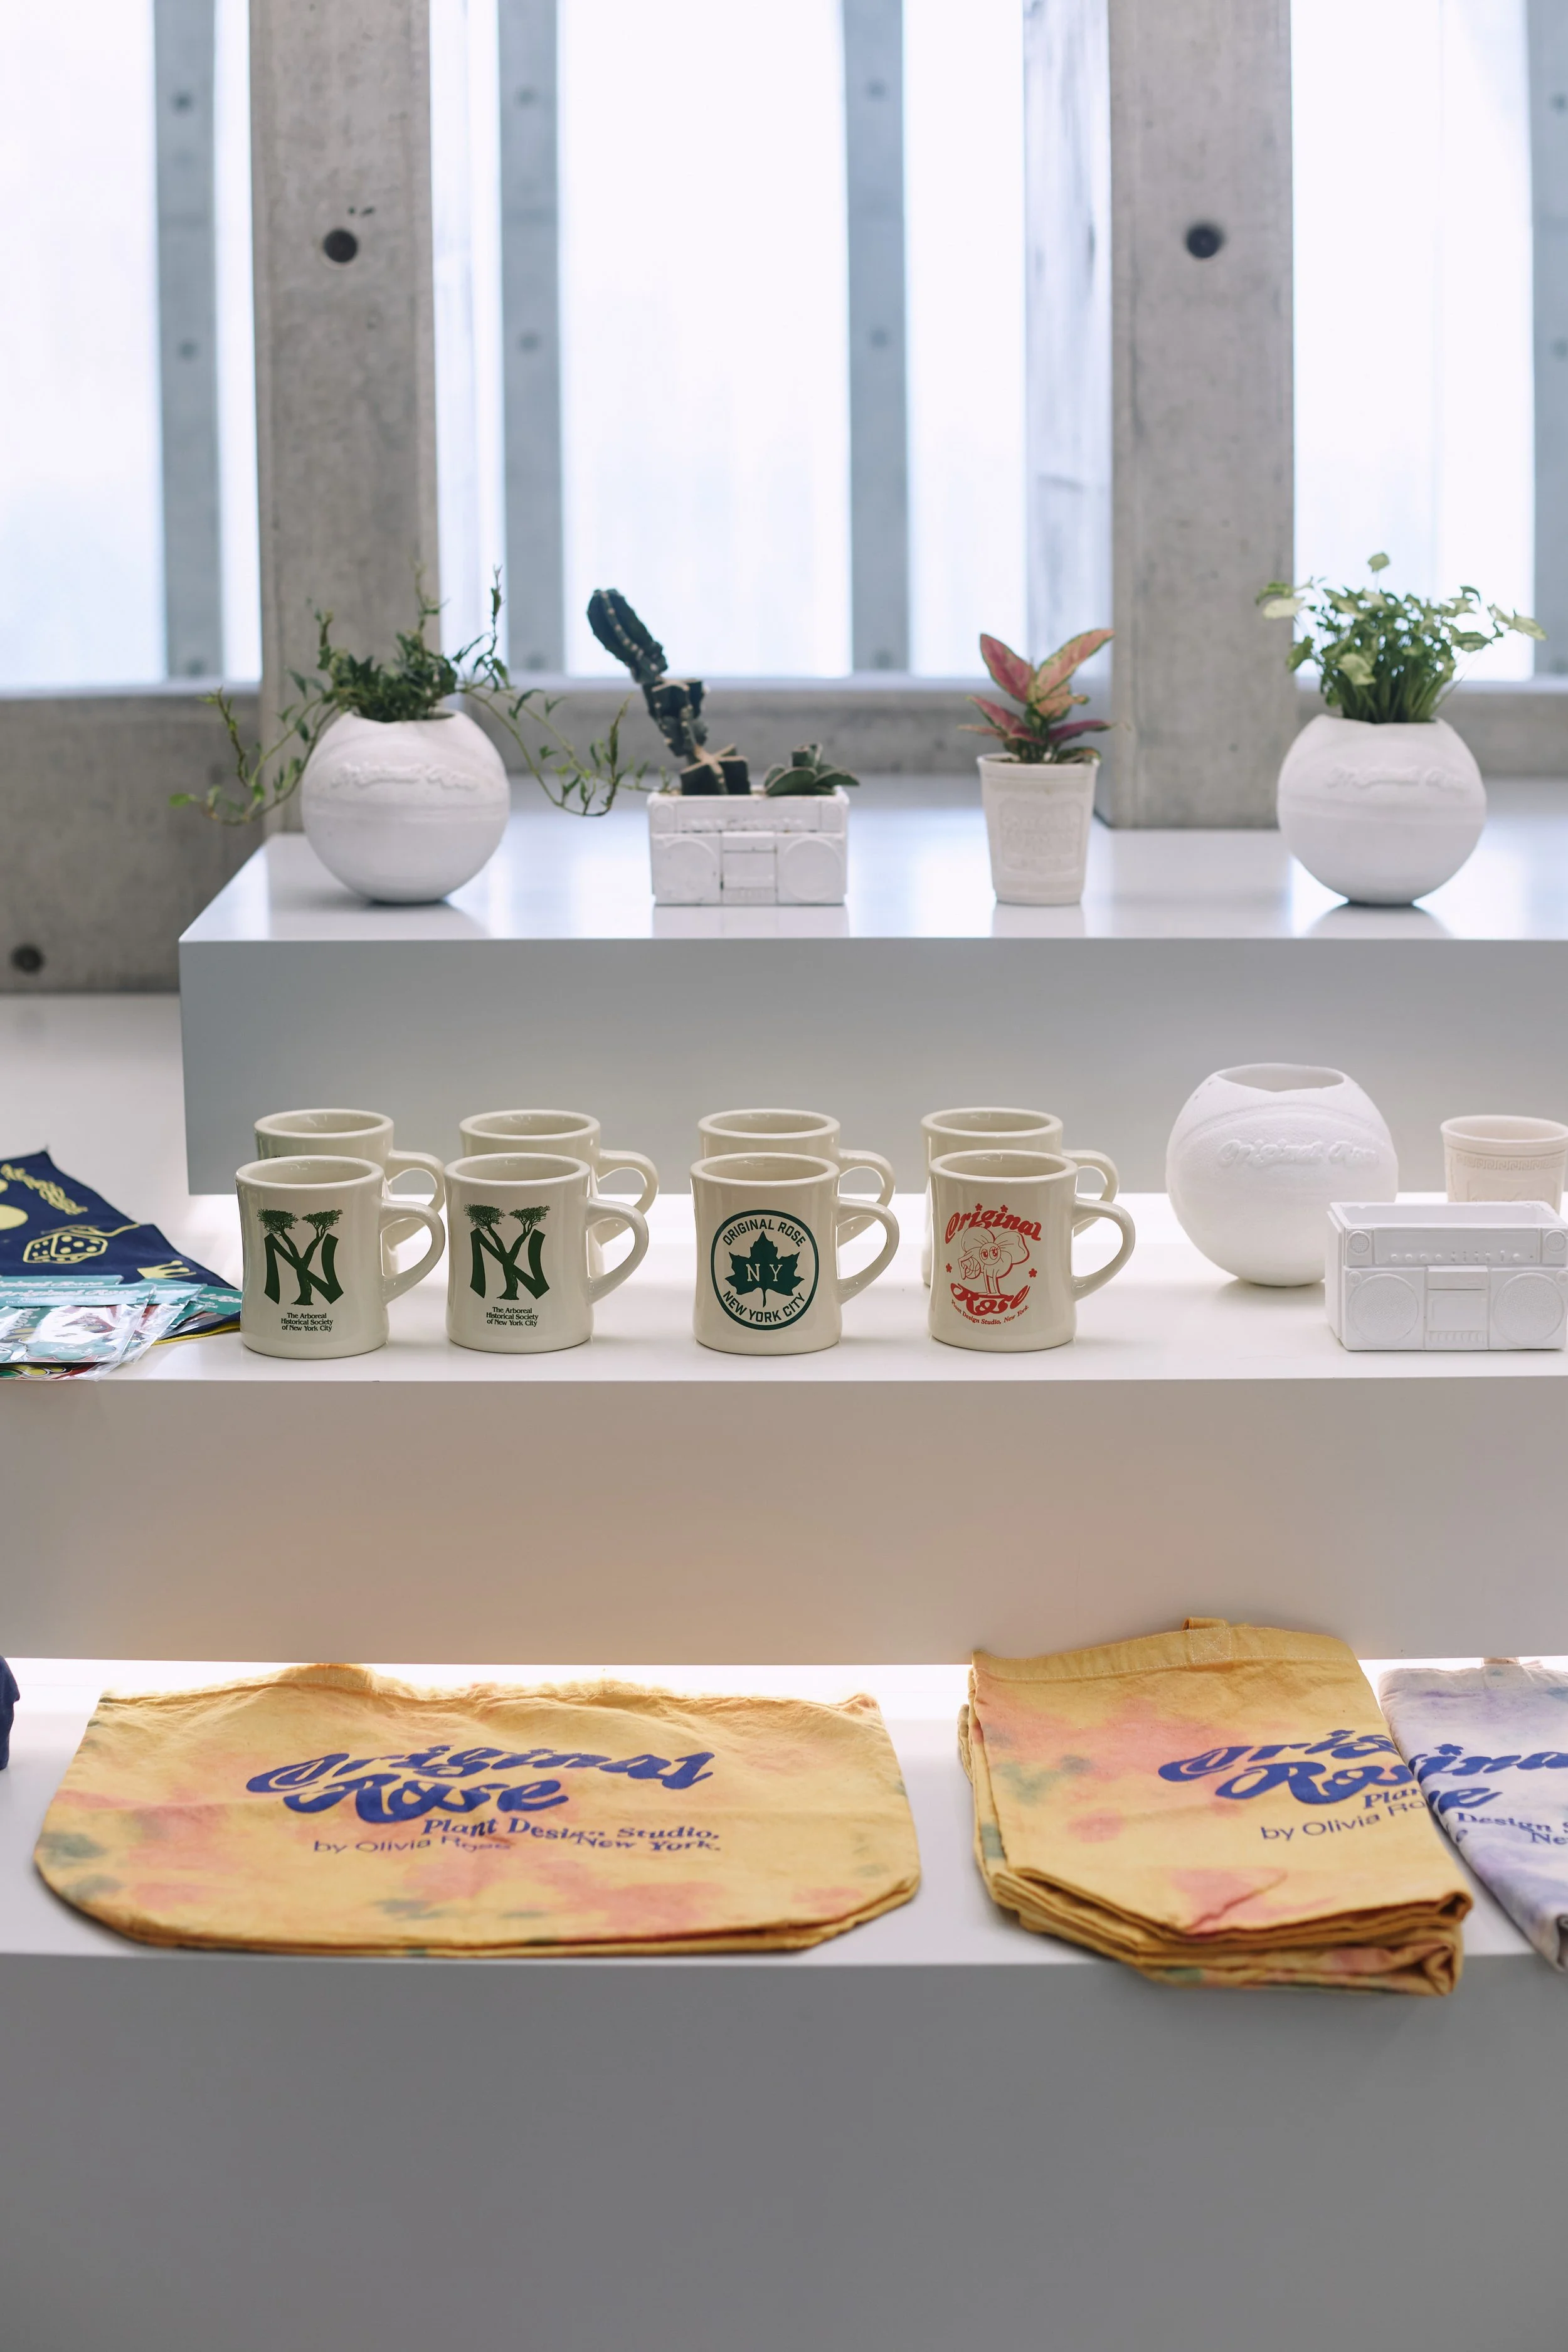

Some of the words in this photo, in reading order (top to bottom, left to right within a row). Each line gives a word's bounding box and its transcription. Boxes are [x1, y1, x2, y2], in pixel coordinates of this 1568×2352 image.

[723, 1219, 774, 1246] ORIGINAL
[777, 1221, 806, 1247] ROSE
[945, 1203, 1042, 1244] Original
[723, 1290, 748, 1316] NEW
[749, 1309, 781, 1323] YORK
[782, 1292, 805, 1316] CITY
[950, 1283, 1030, 1316] Rose
[951, 1298, 962, 1314] Plant
[962, 1310, 980, 1323] Design
[1004, 1315, 1015, 1323] New
[246, 1745, 715, 1793] Original
[283, 1773, 569, 1824] Rose
[421, 1818, 499, 1838] Plant
[616, 1826, 720, 1840] Studio,
[1261, 1826, 1295, 1841] by
[1302, 1813, 1380, 1836] Olivia
[1456, 1811, 1552, 1833] Design
[314, 1840, 347, 1854] by
[355, 1838, 432, 1851] Olivia
[575, 1832, 637, 1849] New
[650, 1840, 721, 1852] York.
